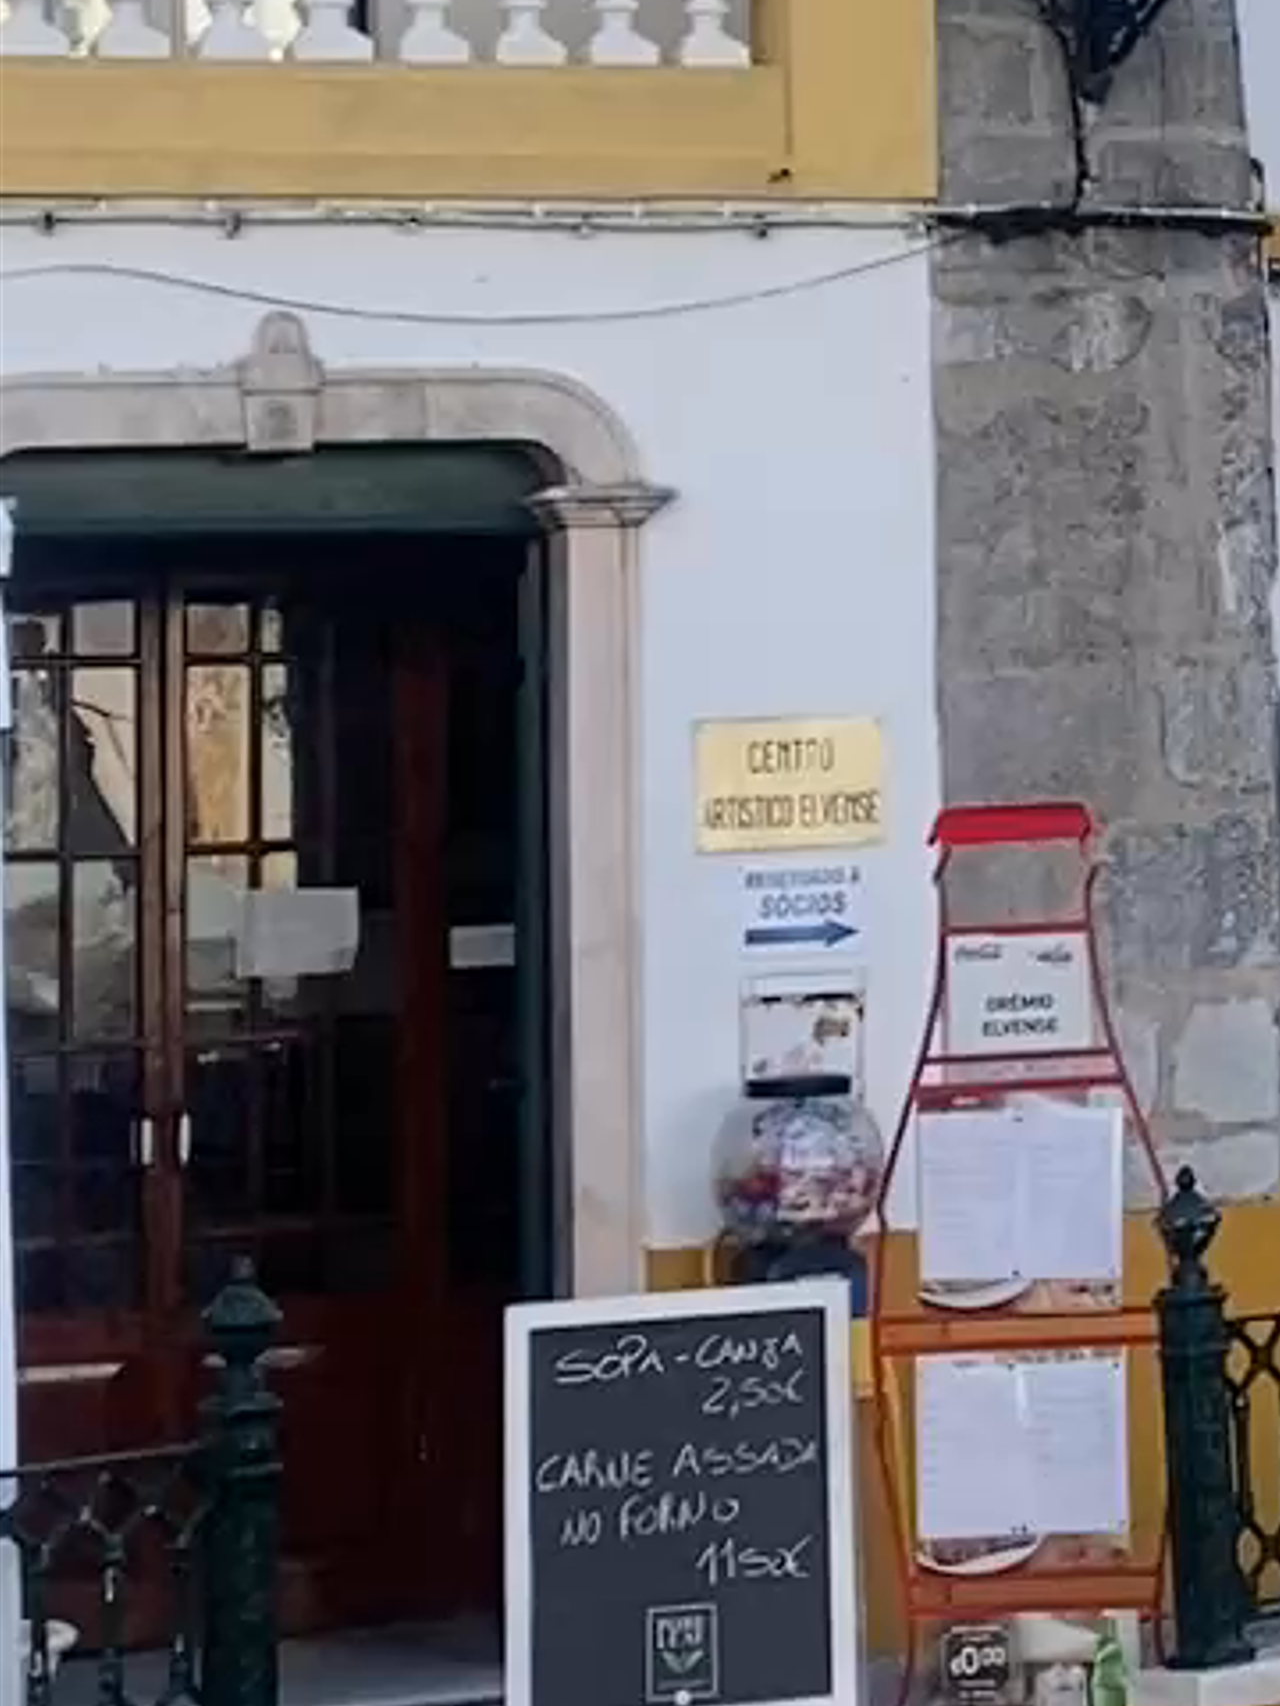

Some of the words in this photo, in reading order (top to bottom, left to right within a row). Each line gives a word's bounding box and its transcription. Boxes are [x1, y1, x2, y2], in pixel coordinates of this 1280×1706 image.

[982, 1017, 1059, 1038] ELVENSE
[555, 1333, 665, 1384] SOPA
[535, 1449, 655, 1492] CARNE
[672, 1437, 818, 1478] ASSADA
[559, 1509, 602, 1546] NO
[618, 1489, 741, 1542] FORNO
